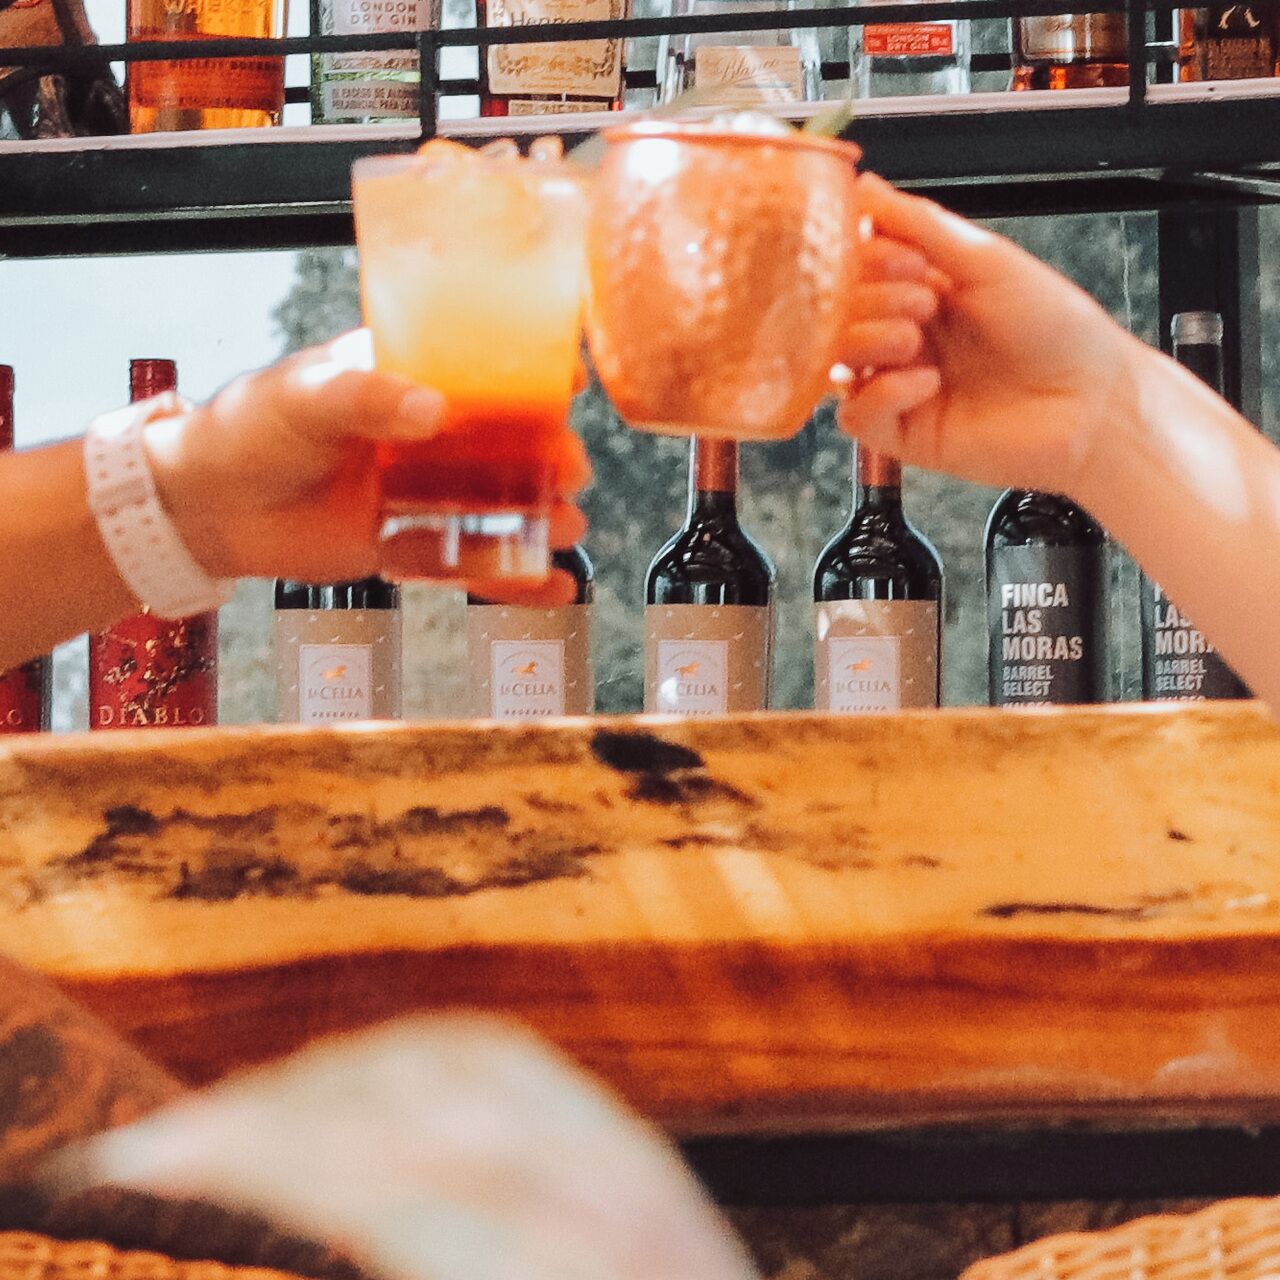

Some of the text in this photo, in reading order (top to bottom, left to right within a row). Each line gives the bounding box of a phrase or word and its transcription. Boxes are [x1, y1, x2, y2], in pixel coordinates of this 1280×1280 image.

[351, 2, 417, 12] LONDON
[351, 14, 417, 24] DRY GIN
[1001, 582, 1069, 608] FINCA
[1002, 609, 1042, 634] LAS
[1002, 635, 1083, 661] MORAS
[1003, 665, 1055, 680] BARREL
[1155, 659, 1208, 675] BARREL
[512, 682, 557, 696] CELIA
[1003, 680, 1052, 696] SELECT
[1156, 674, 1204, 691] SELECT
[319, 686, 365, 700] CELIA
[98, 705, 205, 726] DIABLO
